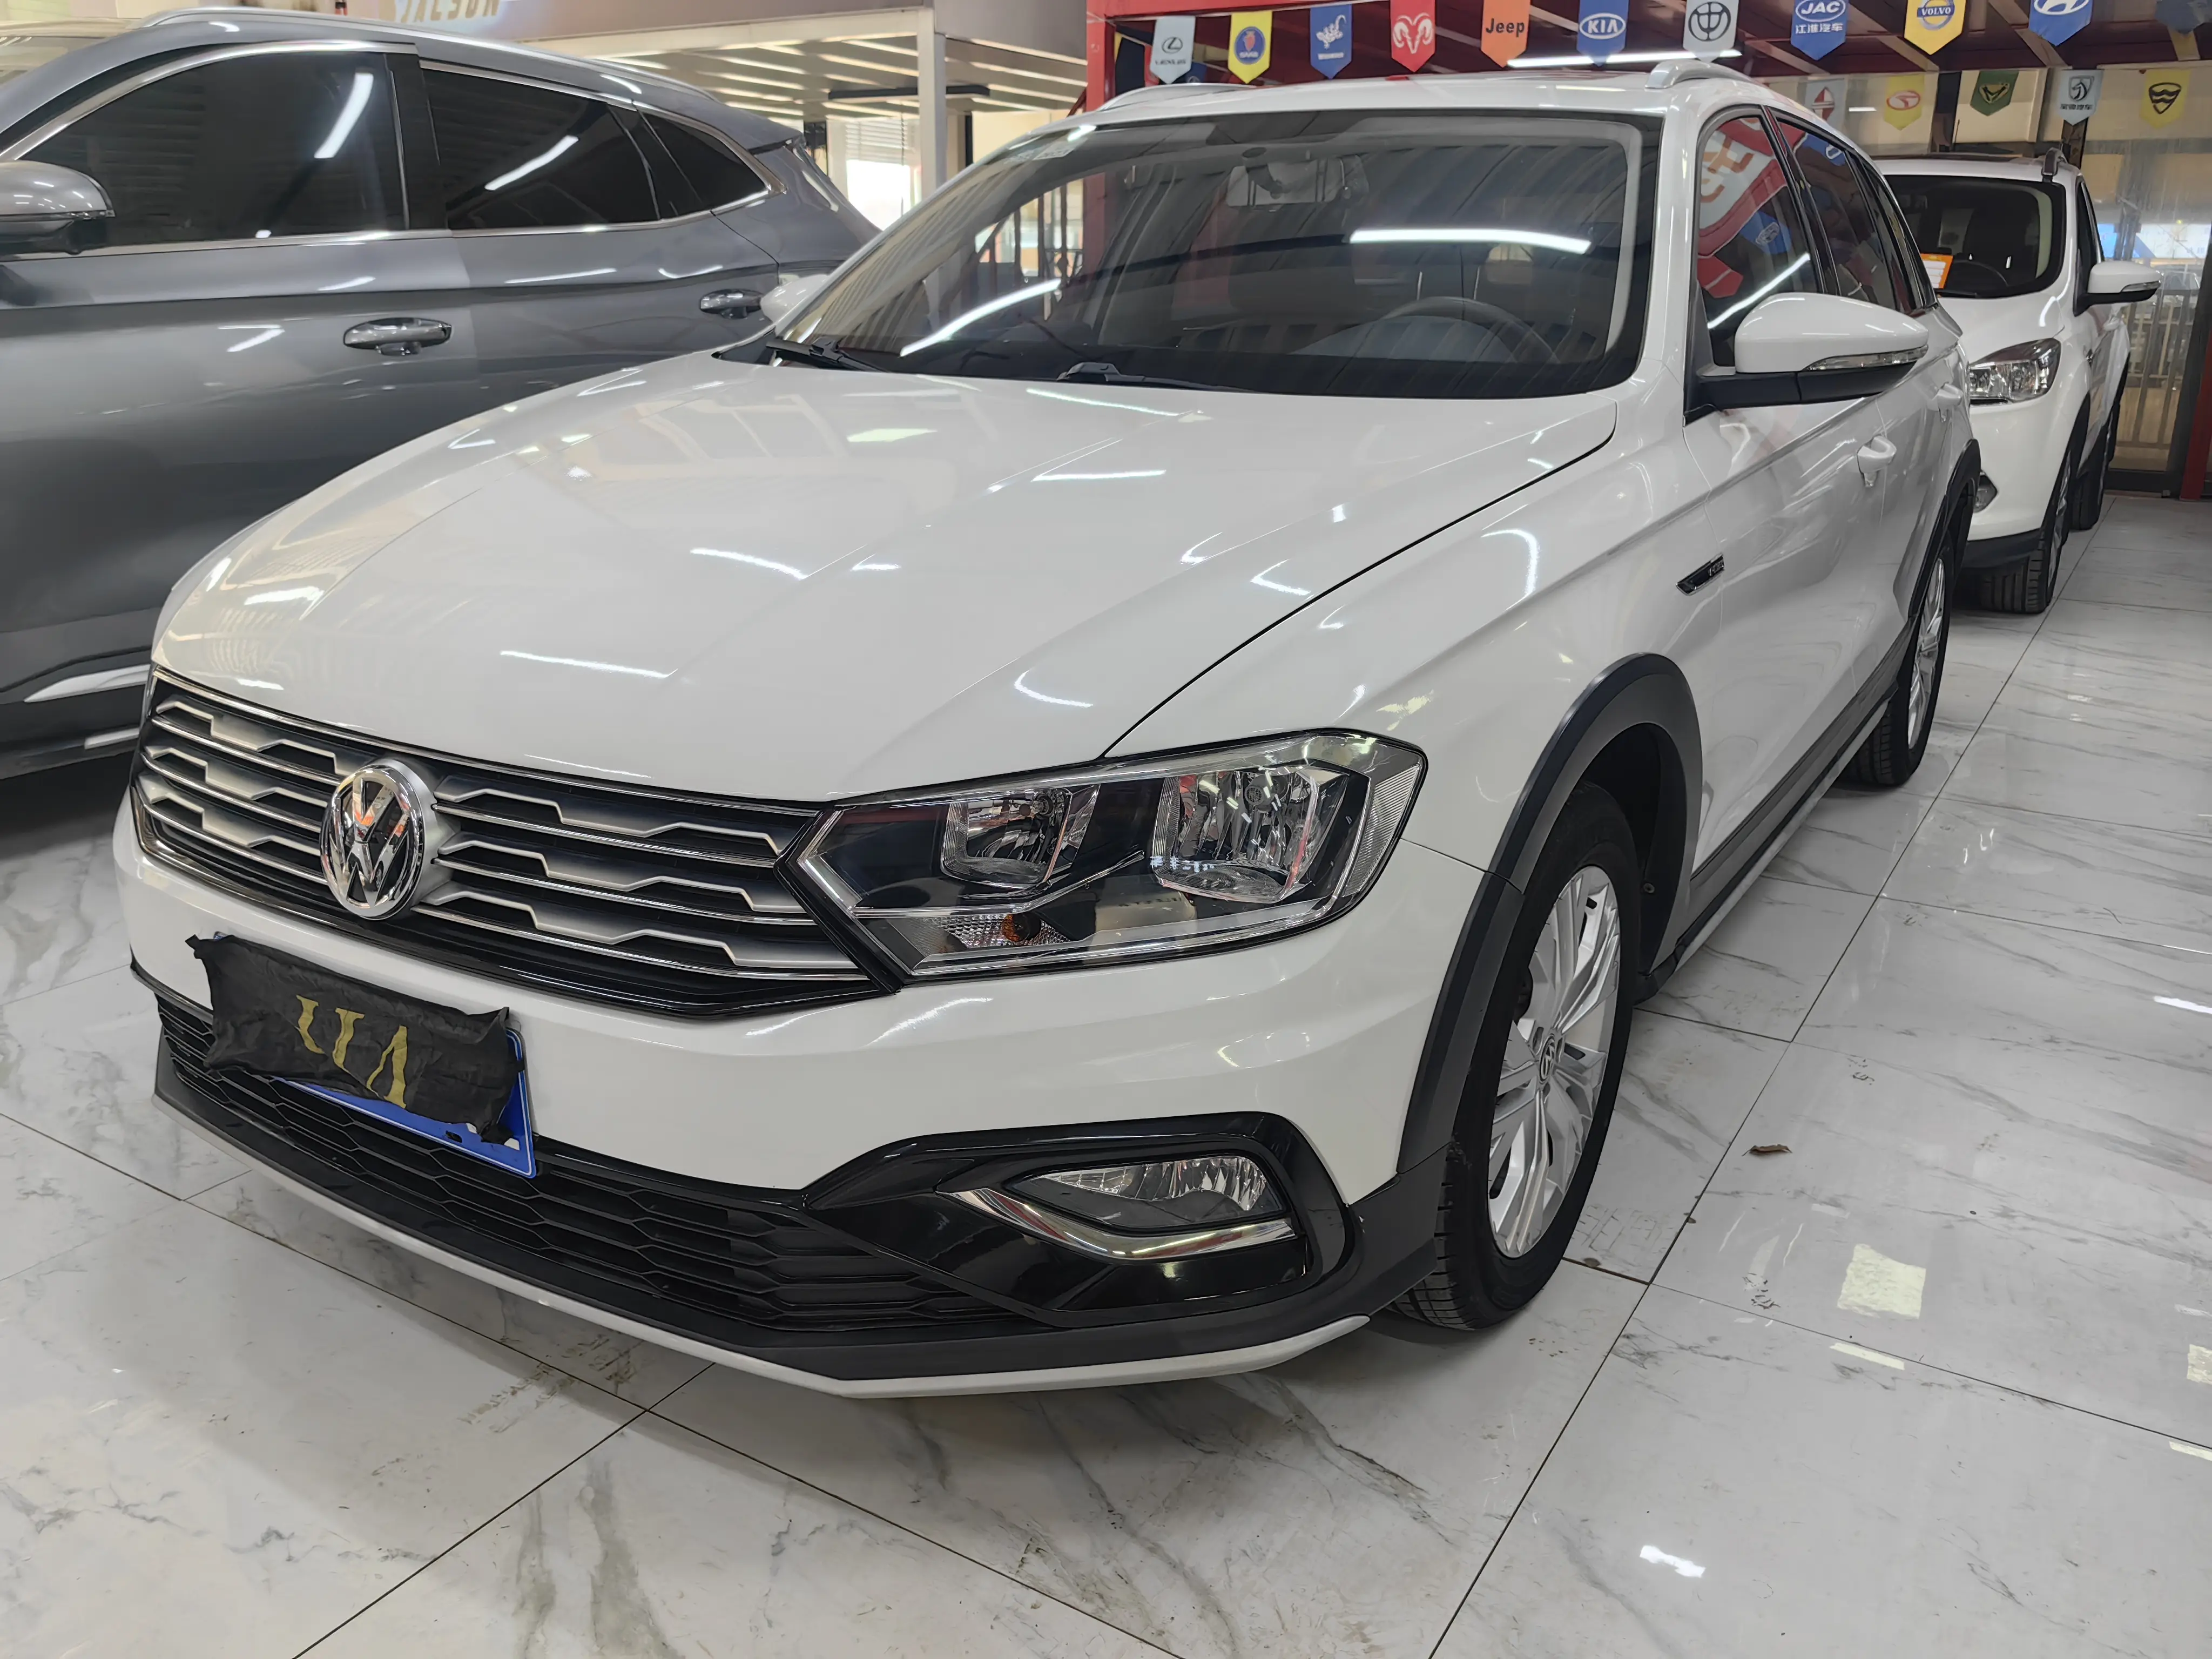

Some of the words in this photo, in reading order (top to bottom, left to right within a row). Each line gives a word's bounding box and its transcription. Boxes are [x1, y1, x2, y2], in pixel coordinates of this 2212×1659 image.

[1801, 1, 1840, 14] JAC
[1921, 7, 1951, 16] VOLVO
[1485, 18, 1525, 37] Jeep
[1587, 19, 1618, 33] KIA
